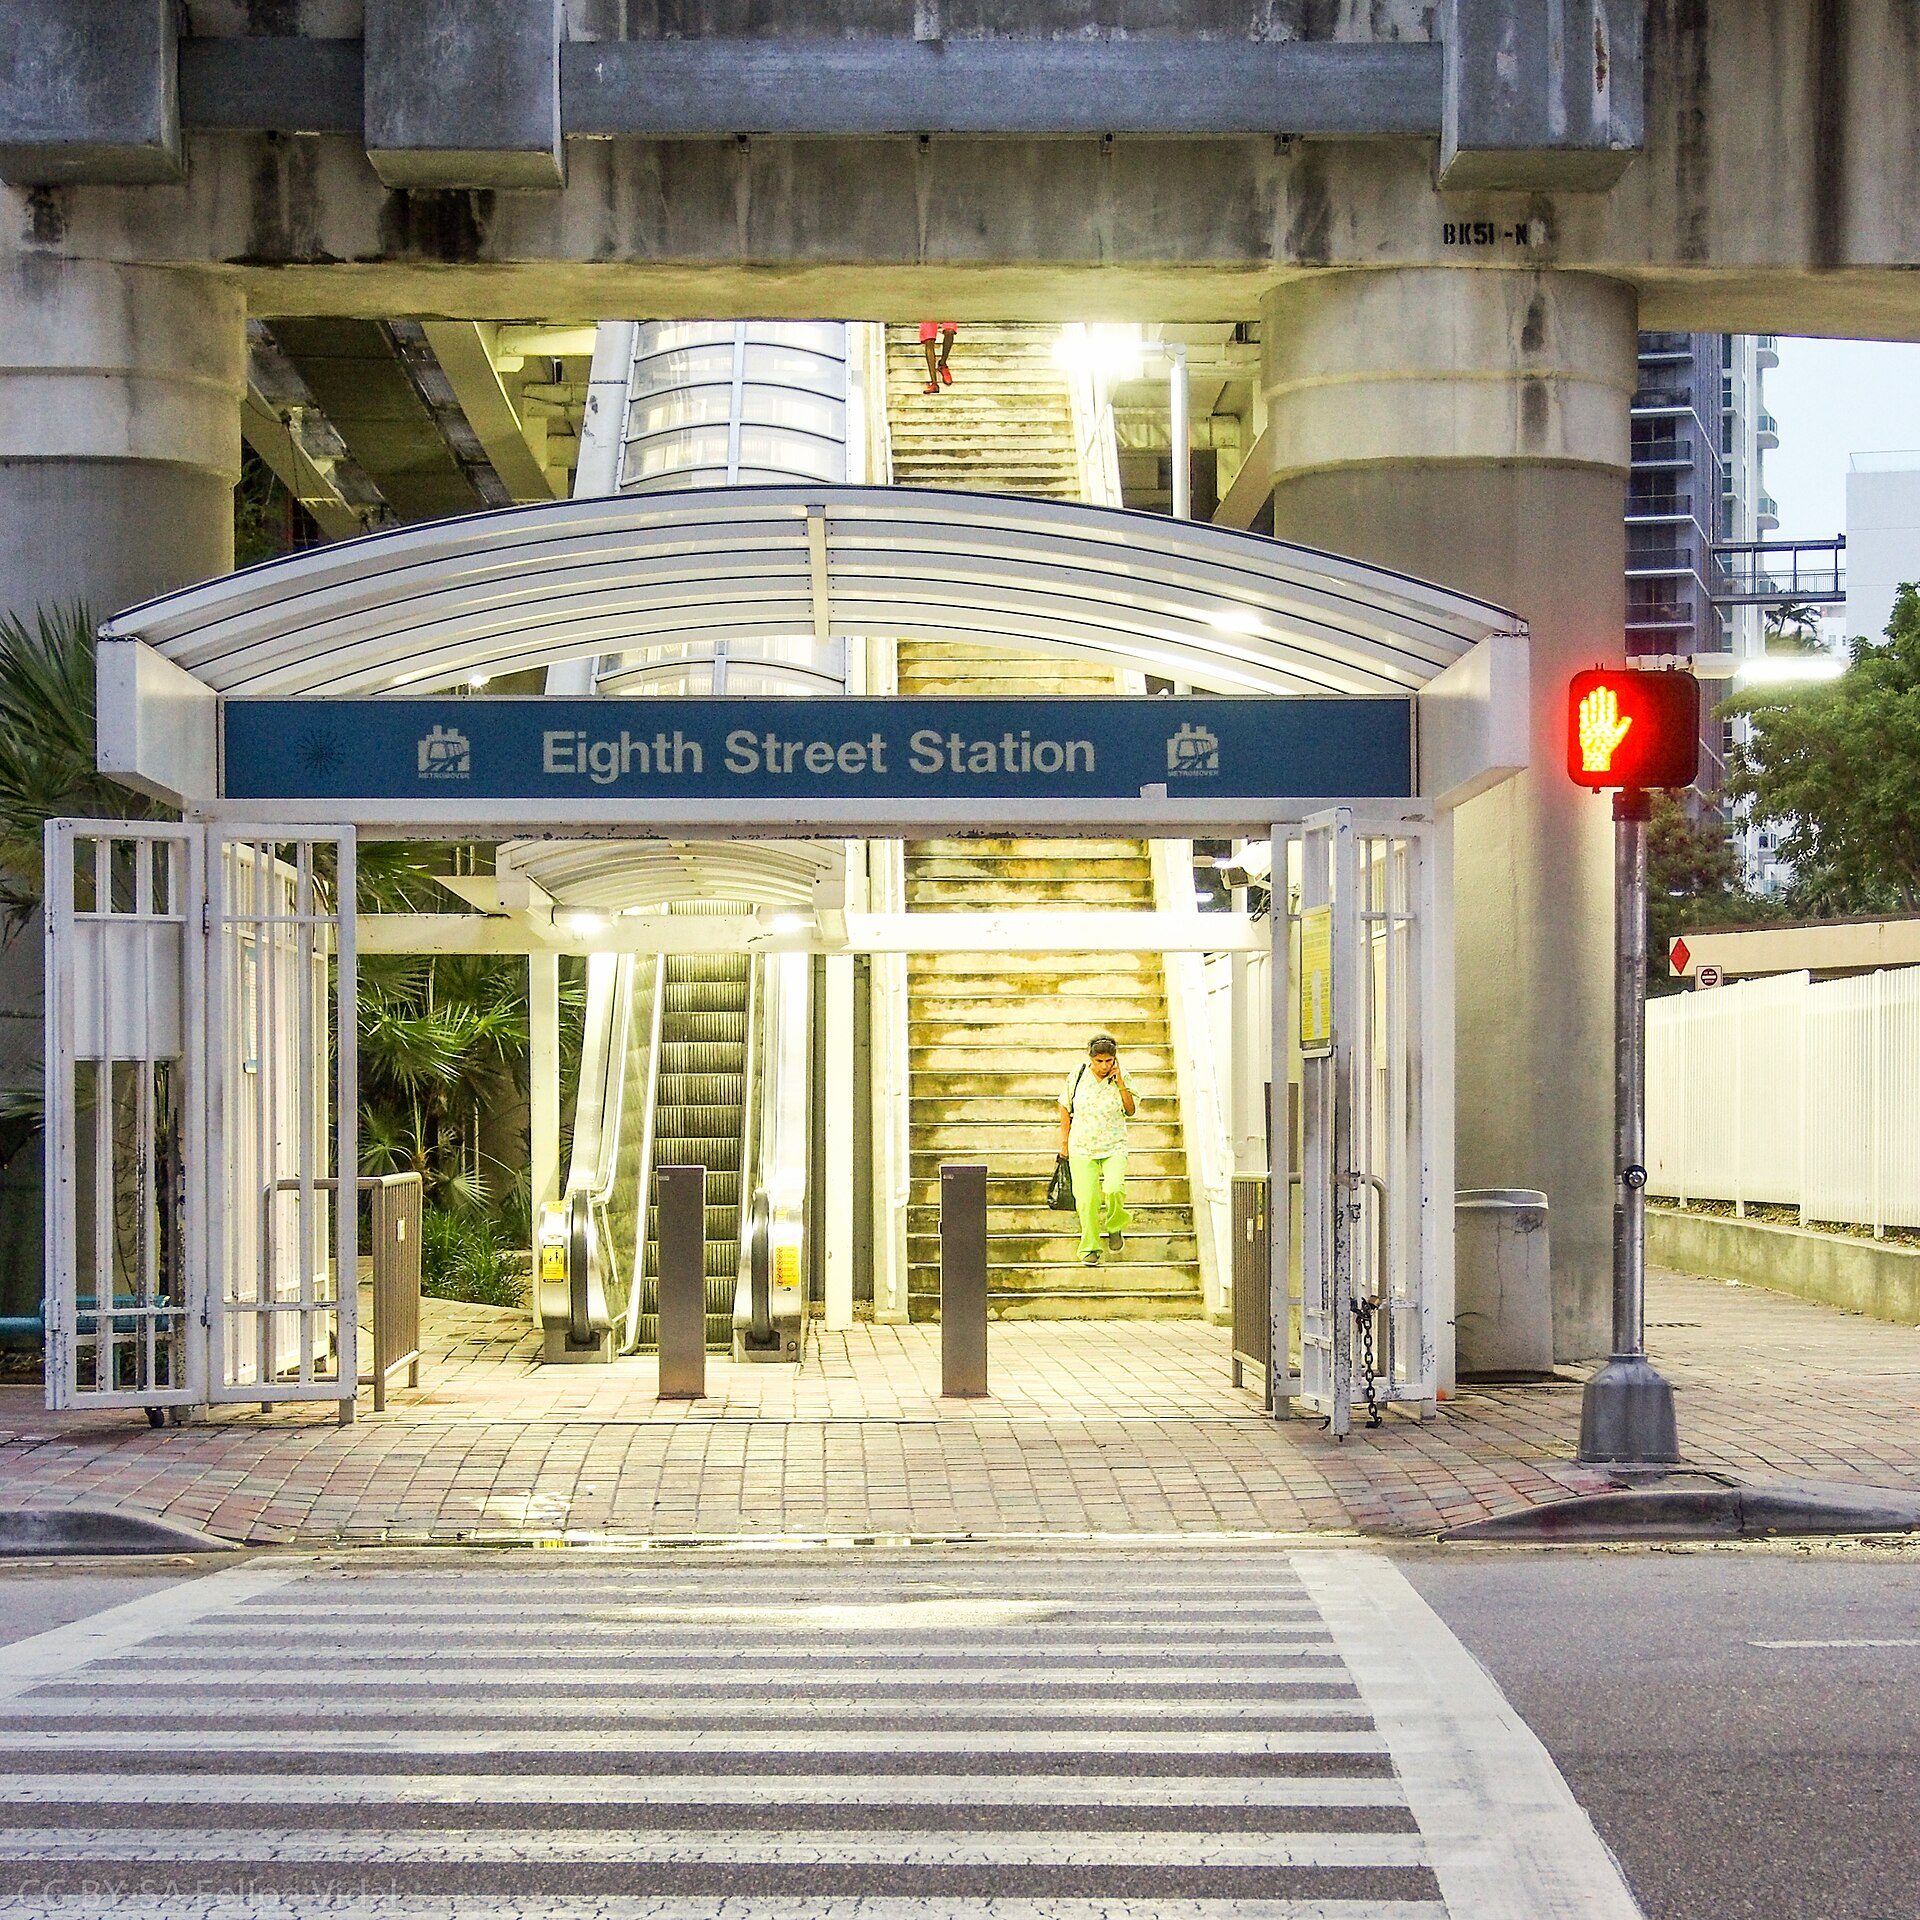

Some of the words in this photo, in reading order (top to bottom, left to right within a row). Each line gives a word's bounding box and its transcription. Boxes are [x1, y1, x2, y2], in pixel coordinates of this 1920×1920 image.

[543, 730, 703, 784] Eighth
[724, 729, 887, 774] Street
[908, 729, 1095, 774] Station
